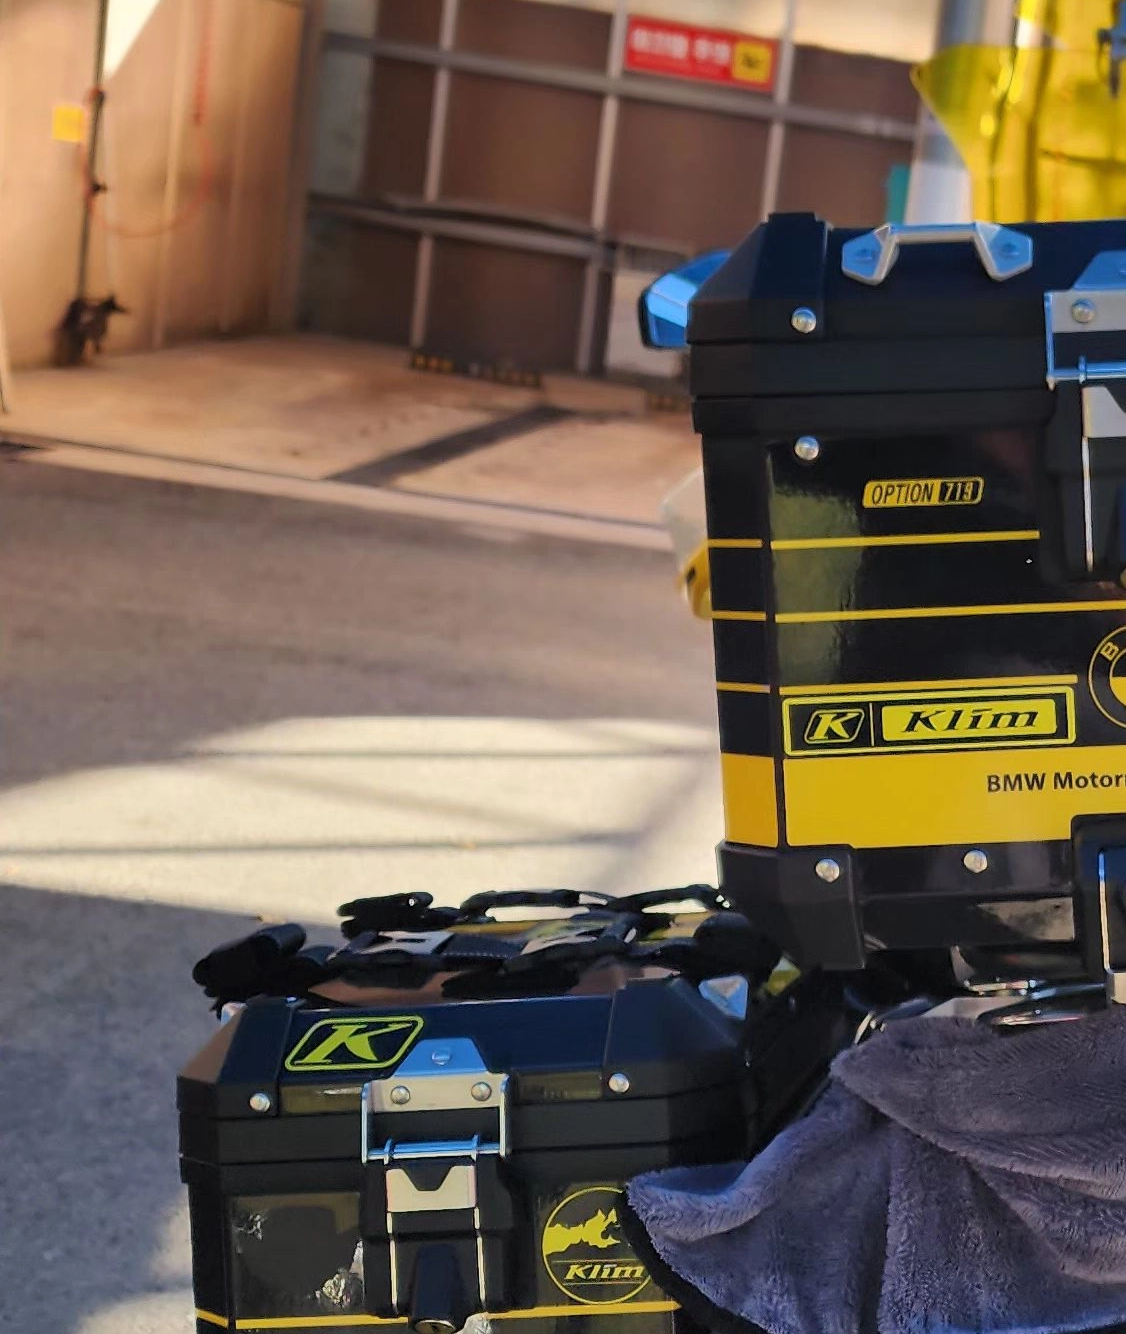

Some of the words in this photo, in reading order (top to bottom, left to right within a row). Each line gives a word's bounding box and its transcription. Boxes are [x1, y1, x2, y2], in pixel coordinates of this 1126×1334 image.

[871, 483, 934, 505] OPTION
[808, 710, 864, 741] K
[900, 703, 1041, 734] Klim
[987, 772, 1046, 794] BMW
[292, 1022, 414, 1066] K
[563, 1263, 646, 1281] Klim
